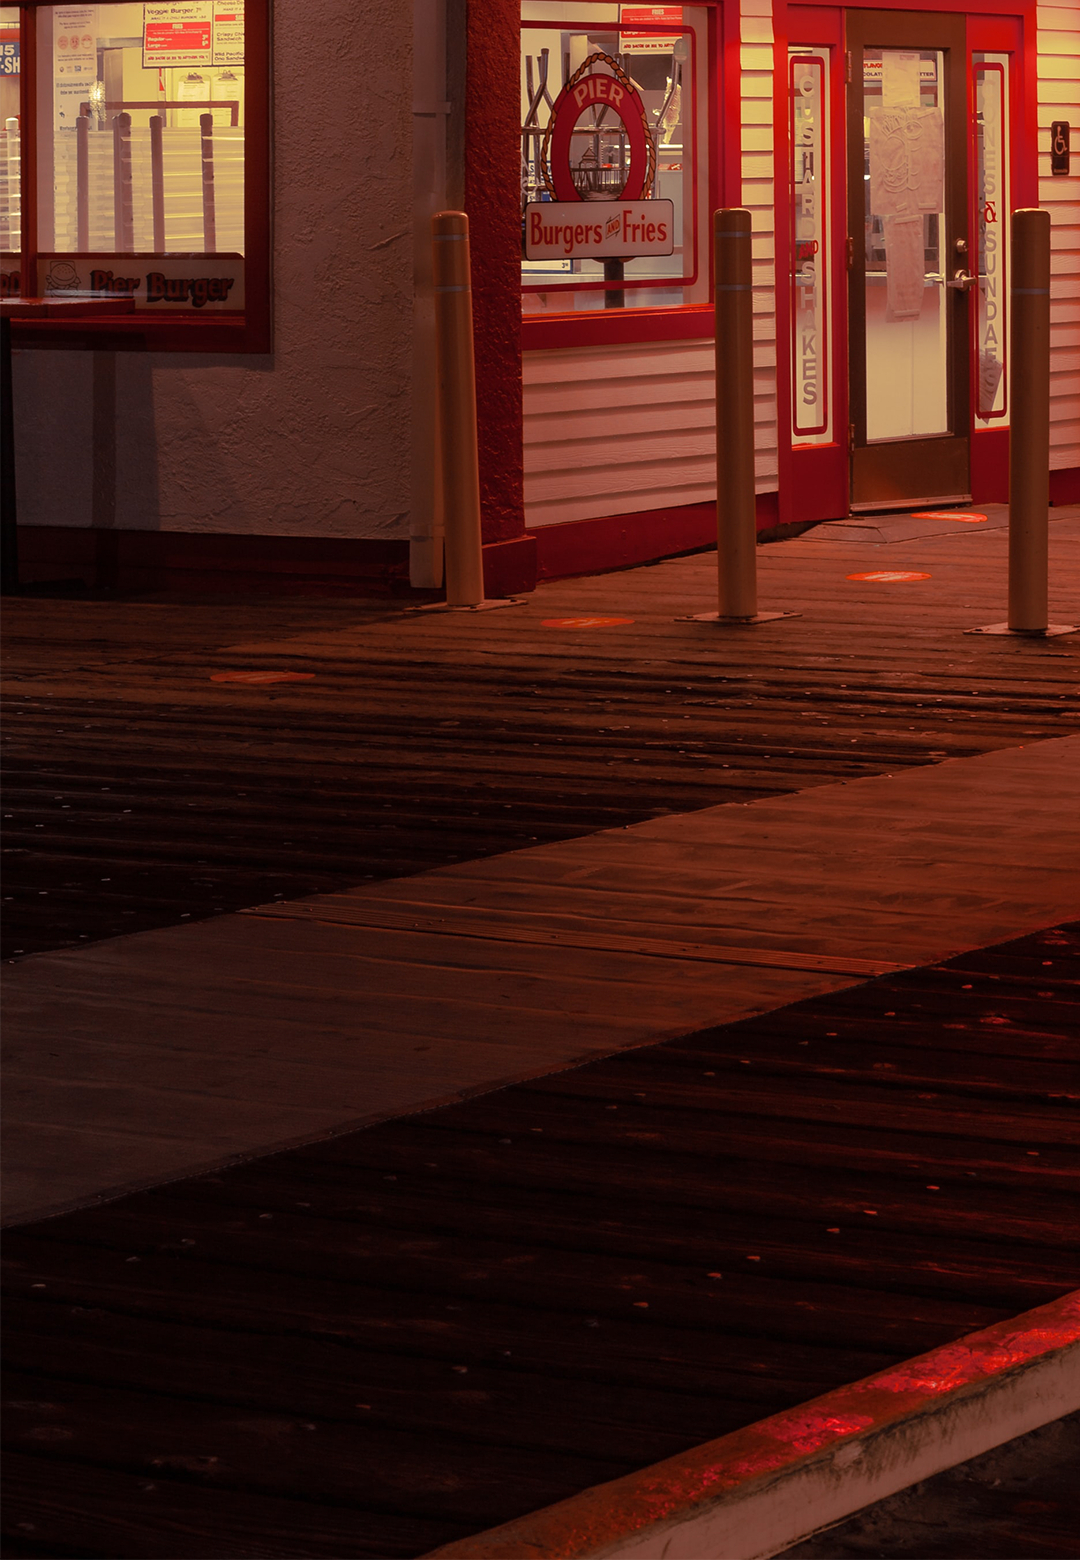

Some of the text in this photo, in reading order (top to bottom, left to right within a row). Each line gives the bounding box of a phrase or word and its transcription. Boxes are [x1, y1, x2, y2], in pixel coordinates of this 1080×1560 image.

[573, 78, 624, 109] PIER
[530, 209, 667, 254] Burgers AND Fries
[799, 239, 819, 260] AND
[90, 269, 235, 308] Pier Burger
[801, 260, 818, 406] SHAKES
